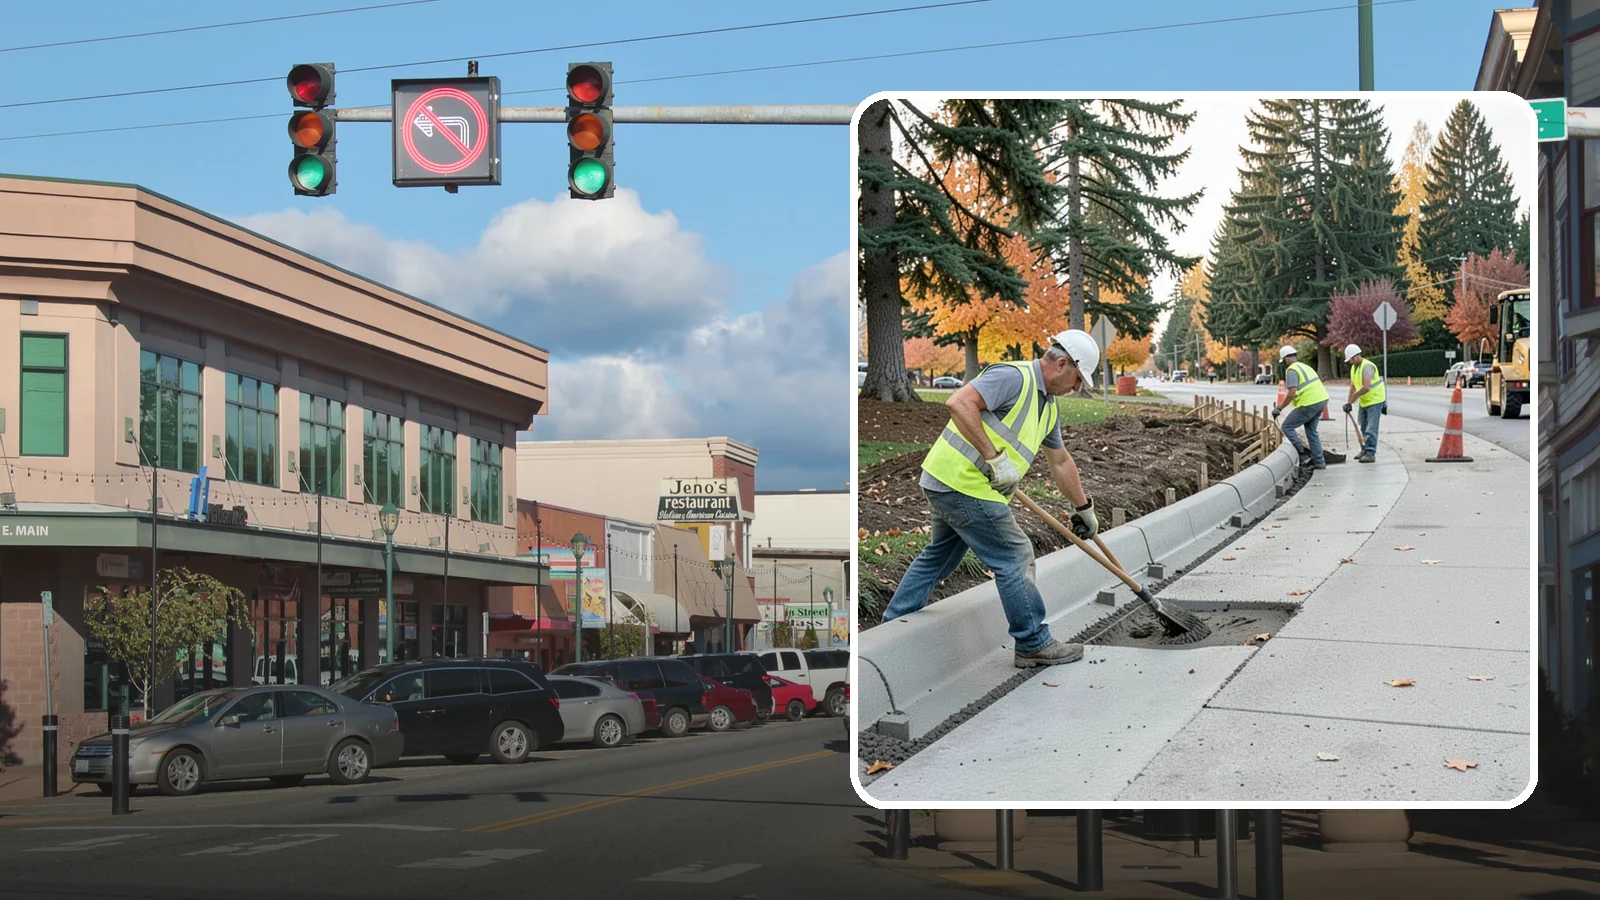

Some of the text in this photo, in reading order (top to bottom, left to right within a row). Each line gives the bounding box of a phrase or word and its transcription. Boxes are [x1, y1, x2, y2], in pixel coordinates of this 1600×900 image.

[670, 480, 727, 494] Jeno's
[665, 496, 731, 509] restaurant
[658, 510, 682, 519] Italian
[686, 510, 714, 519] American
[715, 509, 737, 519] Cuisine
[2, 525, 49, 536] E. MAIN
[797, 608, 828, 616] Street
